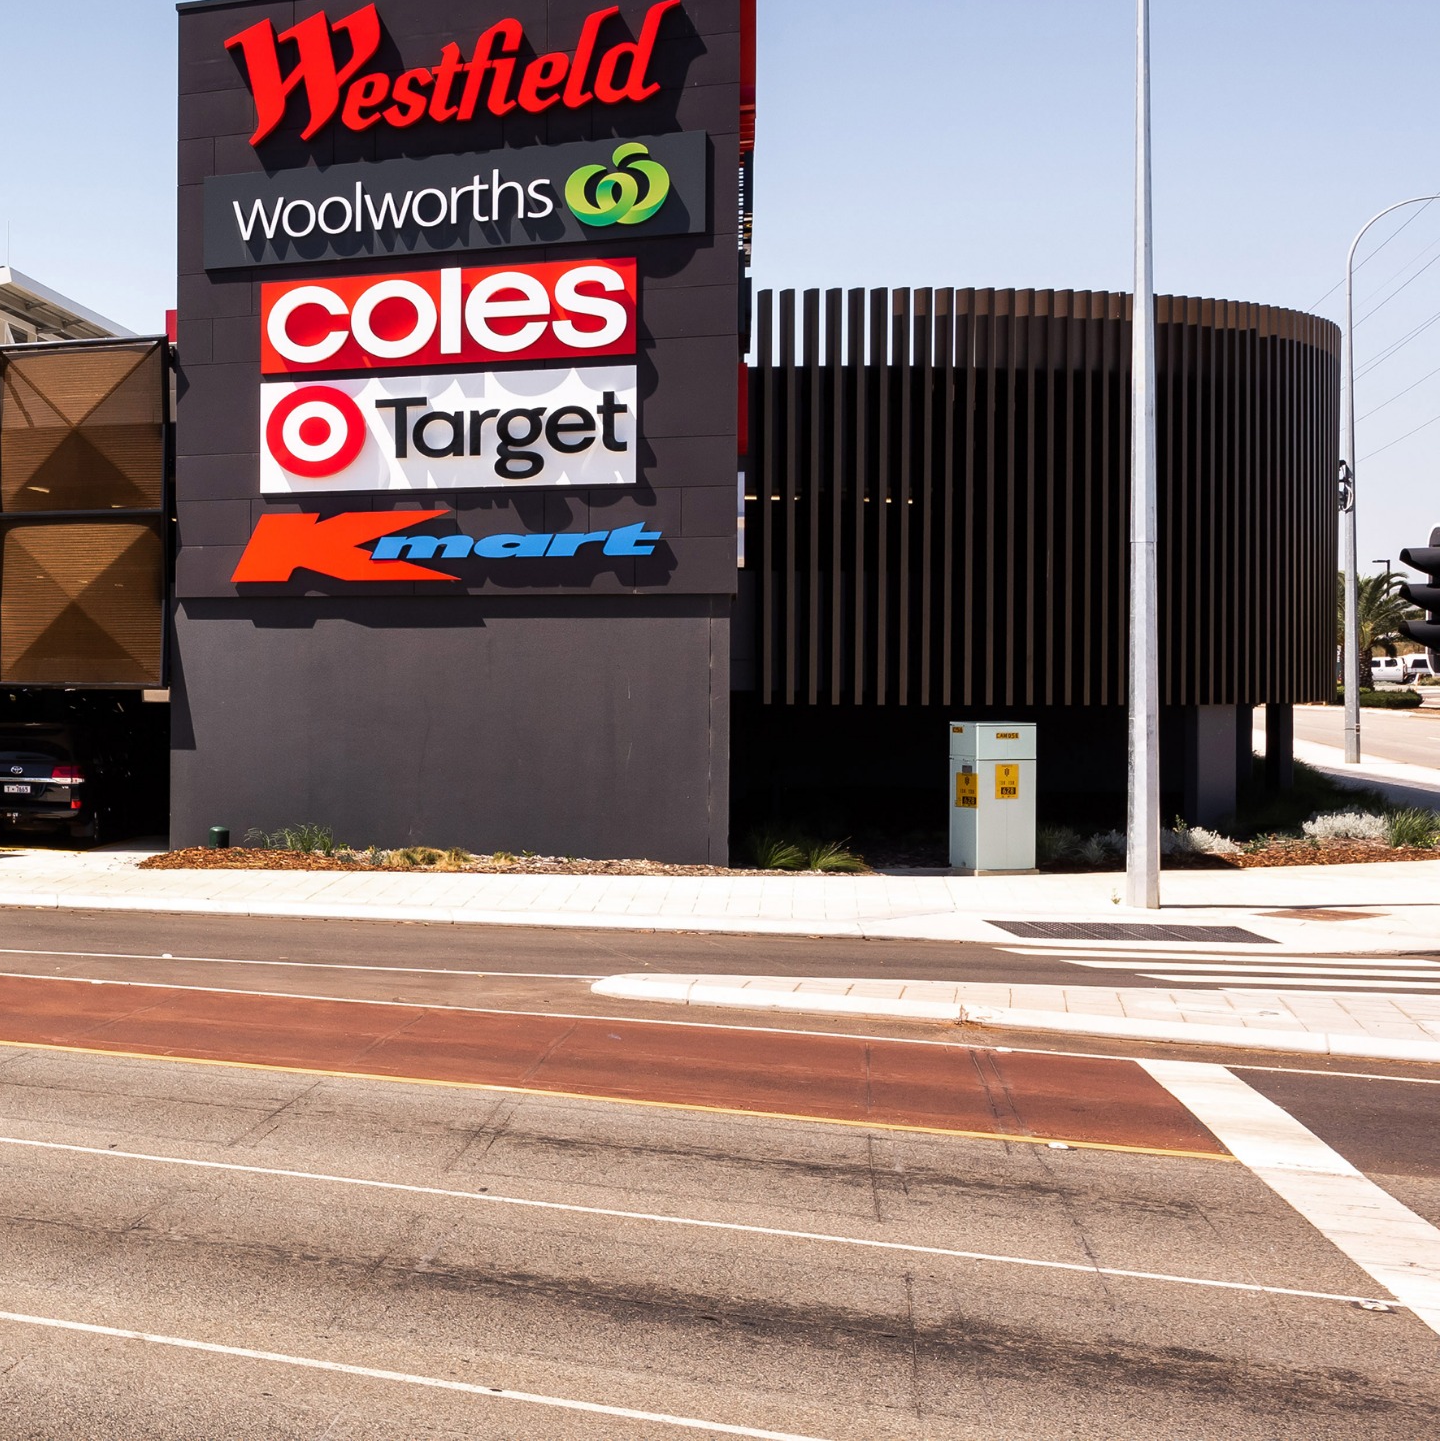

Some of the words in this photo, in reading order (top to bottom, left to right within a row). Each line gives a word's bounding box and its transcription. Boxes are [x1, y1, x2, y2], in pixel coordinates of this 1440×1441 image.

[267, 265, 627, 364] coles
[375, 390, 629, 480] Target
[230, 509, 663, 583] Kmart
